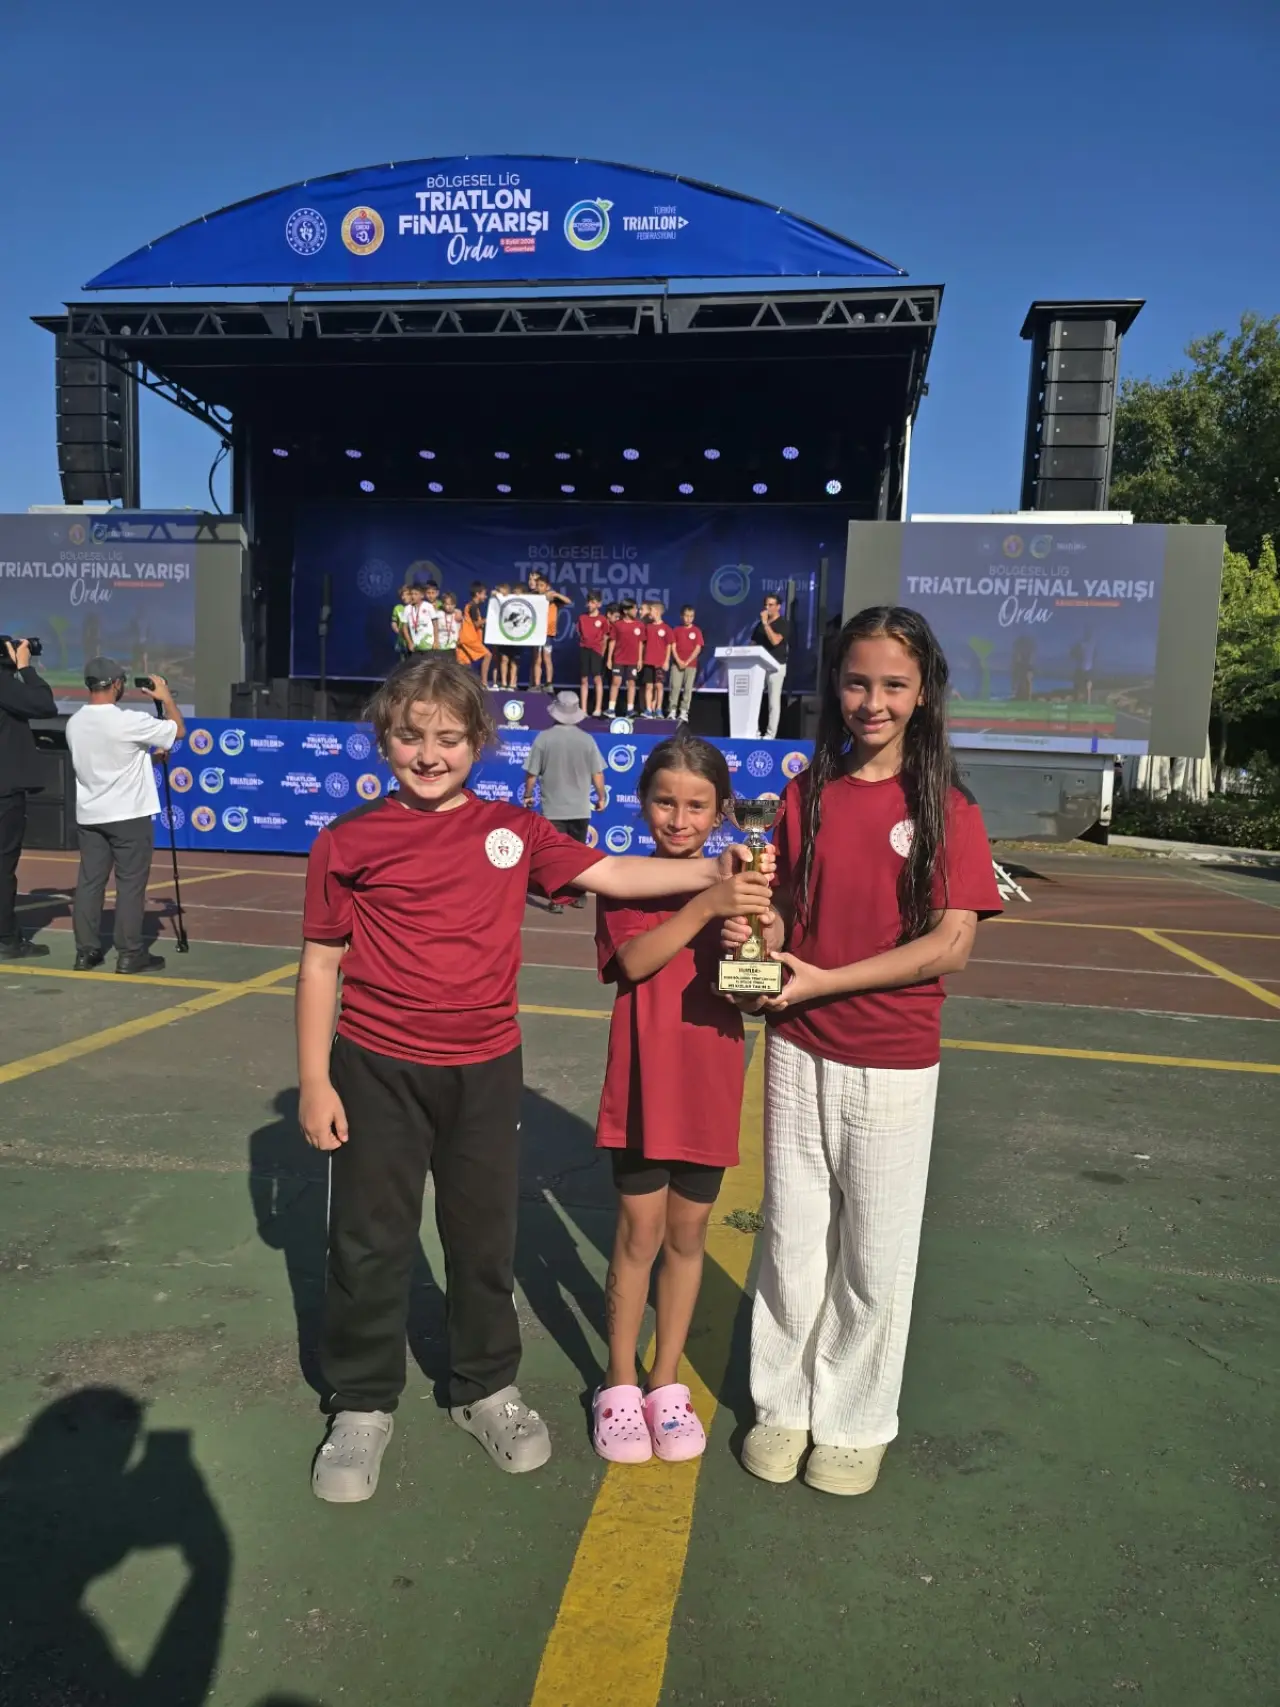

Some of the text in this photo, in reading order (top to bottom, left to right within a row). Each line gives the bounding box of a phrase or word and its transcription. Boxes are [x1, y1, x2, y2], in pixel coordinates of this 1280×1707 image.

[427, 172, 520, 188] BÖLGESEL LİG
[472, 211, 549, 235] YARIŞI
[447, 234, 499, 265] Ordu
[528, 544, 609, 559] BÖLGESEL
[134, 563, 190, 582] YARIŞI
[70, 578, 113, 606] Ordu
[1084, 579, 1155, 602] YARIŞI
[998, 596, 1055, 627] Ordu
